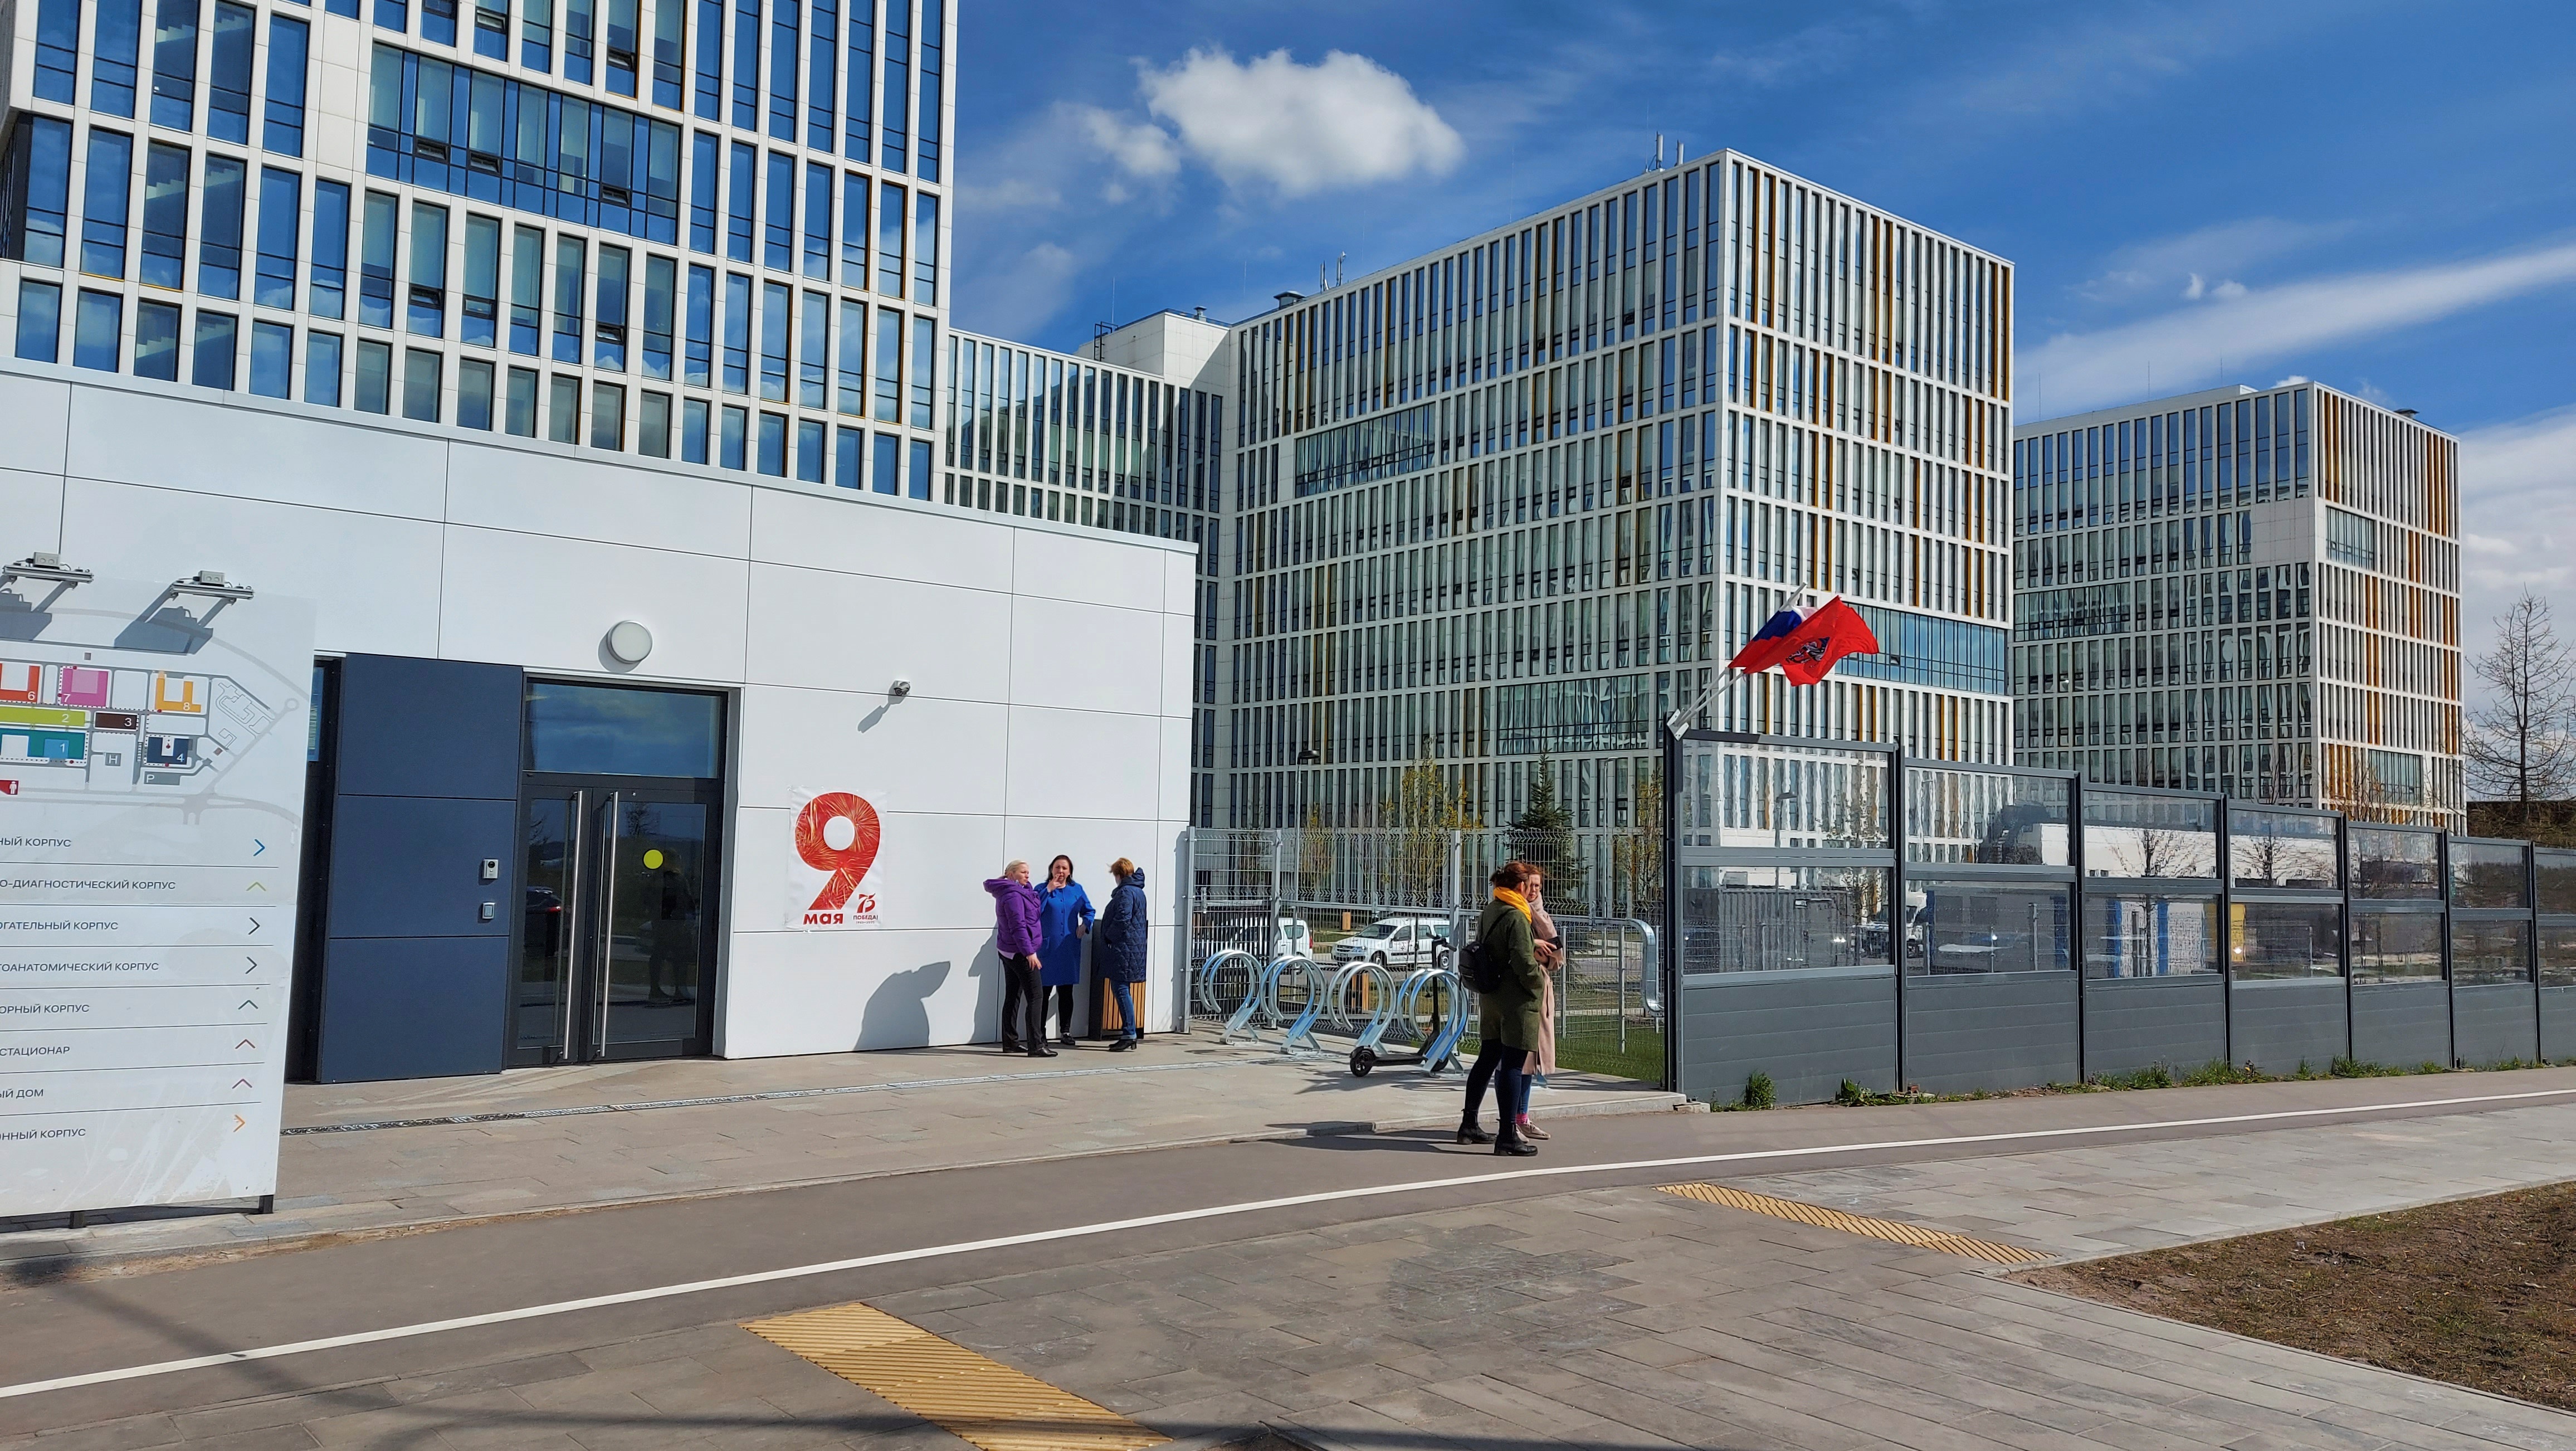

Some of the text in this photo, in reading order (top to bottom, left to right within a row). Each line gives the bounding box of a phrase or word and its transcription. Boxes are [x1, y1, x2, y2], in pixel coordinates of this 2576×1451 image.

[27, 691, 36, 700] 6
[64, 694, 71, 703] 7
[183, 702, 191, 710] 8
[61, 714, 69, 723] 2
[124, 717, 132, 727] 3
[60, 743, 65, 753] 1
[108, 754, 118, 765] H
[176, 753, 185, 762] 4
[146, 774, 155, 783] P
[25, 838, 72, 847] КОРПУС
[794, 792, 880, 910] 9
[131, 882, 176, 890] КОРПУС
[856, 893, 876, 913] 75
[74, 922, 119, 930] КОРПУС
[0, 961, 159, 972] ОАНАТОМИЧЕСКИЙ КОРПУС
[0, 1004, 90, 1014] ОРНЫЙ КОРПУС
[0, 1046, 70, 1056] СТАЦИОНАР
[16, 1089, 44, 1099] ДОМ
[0, 1128, 86, 1141] ННЫЙ КОРПУС
